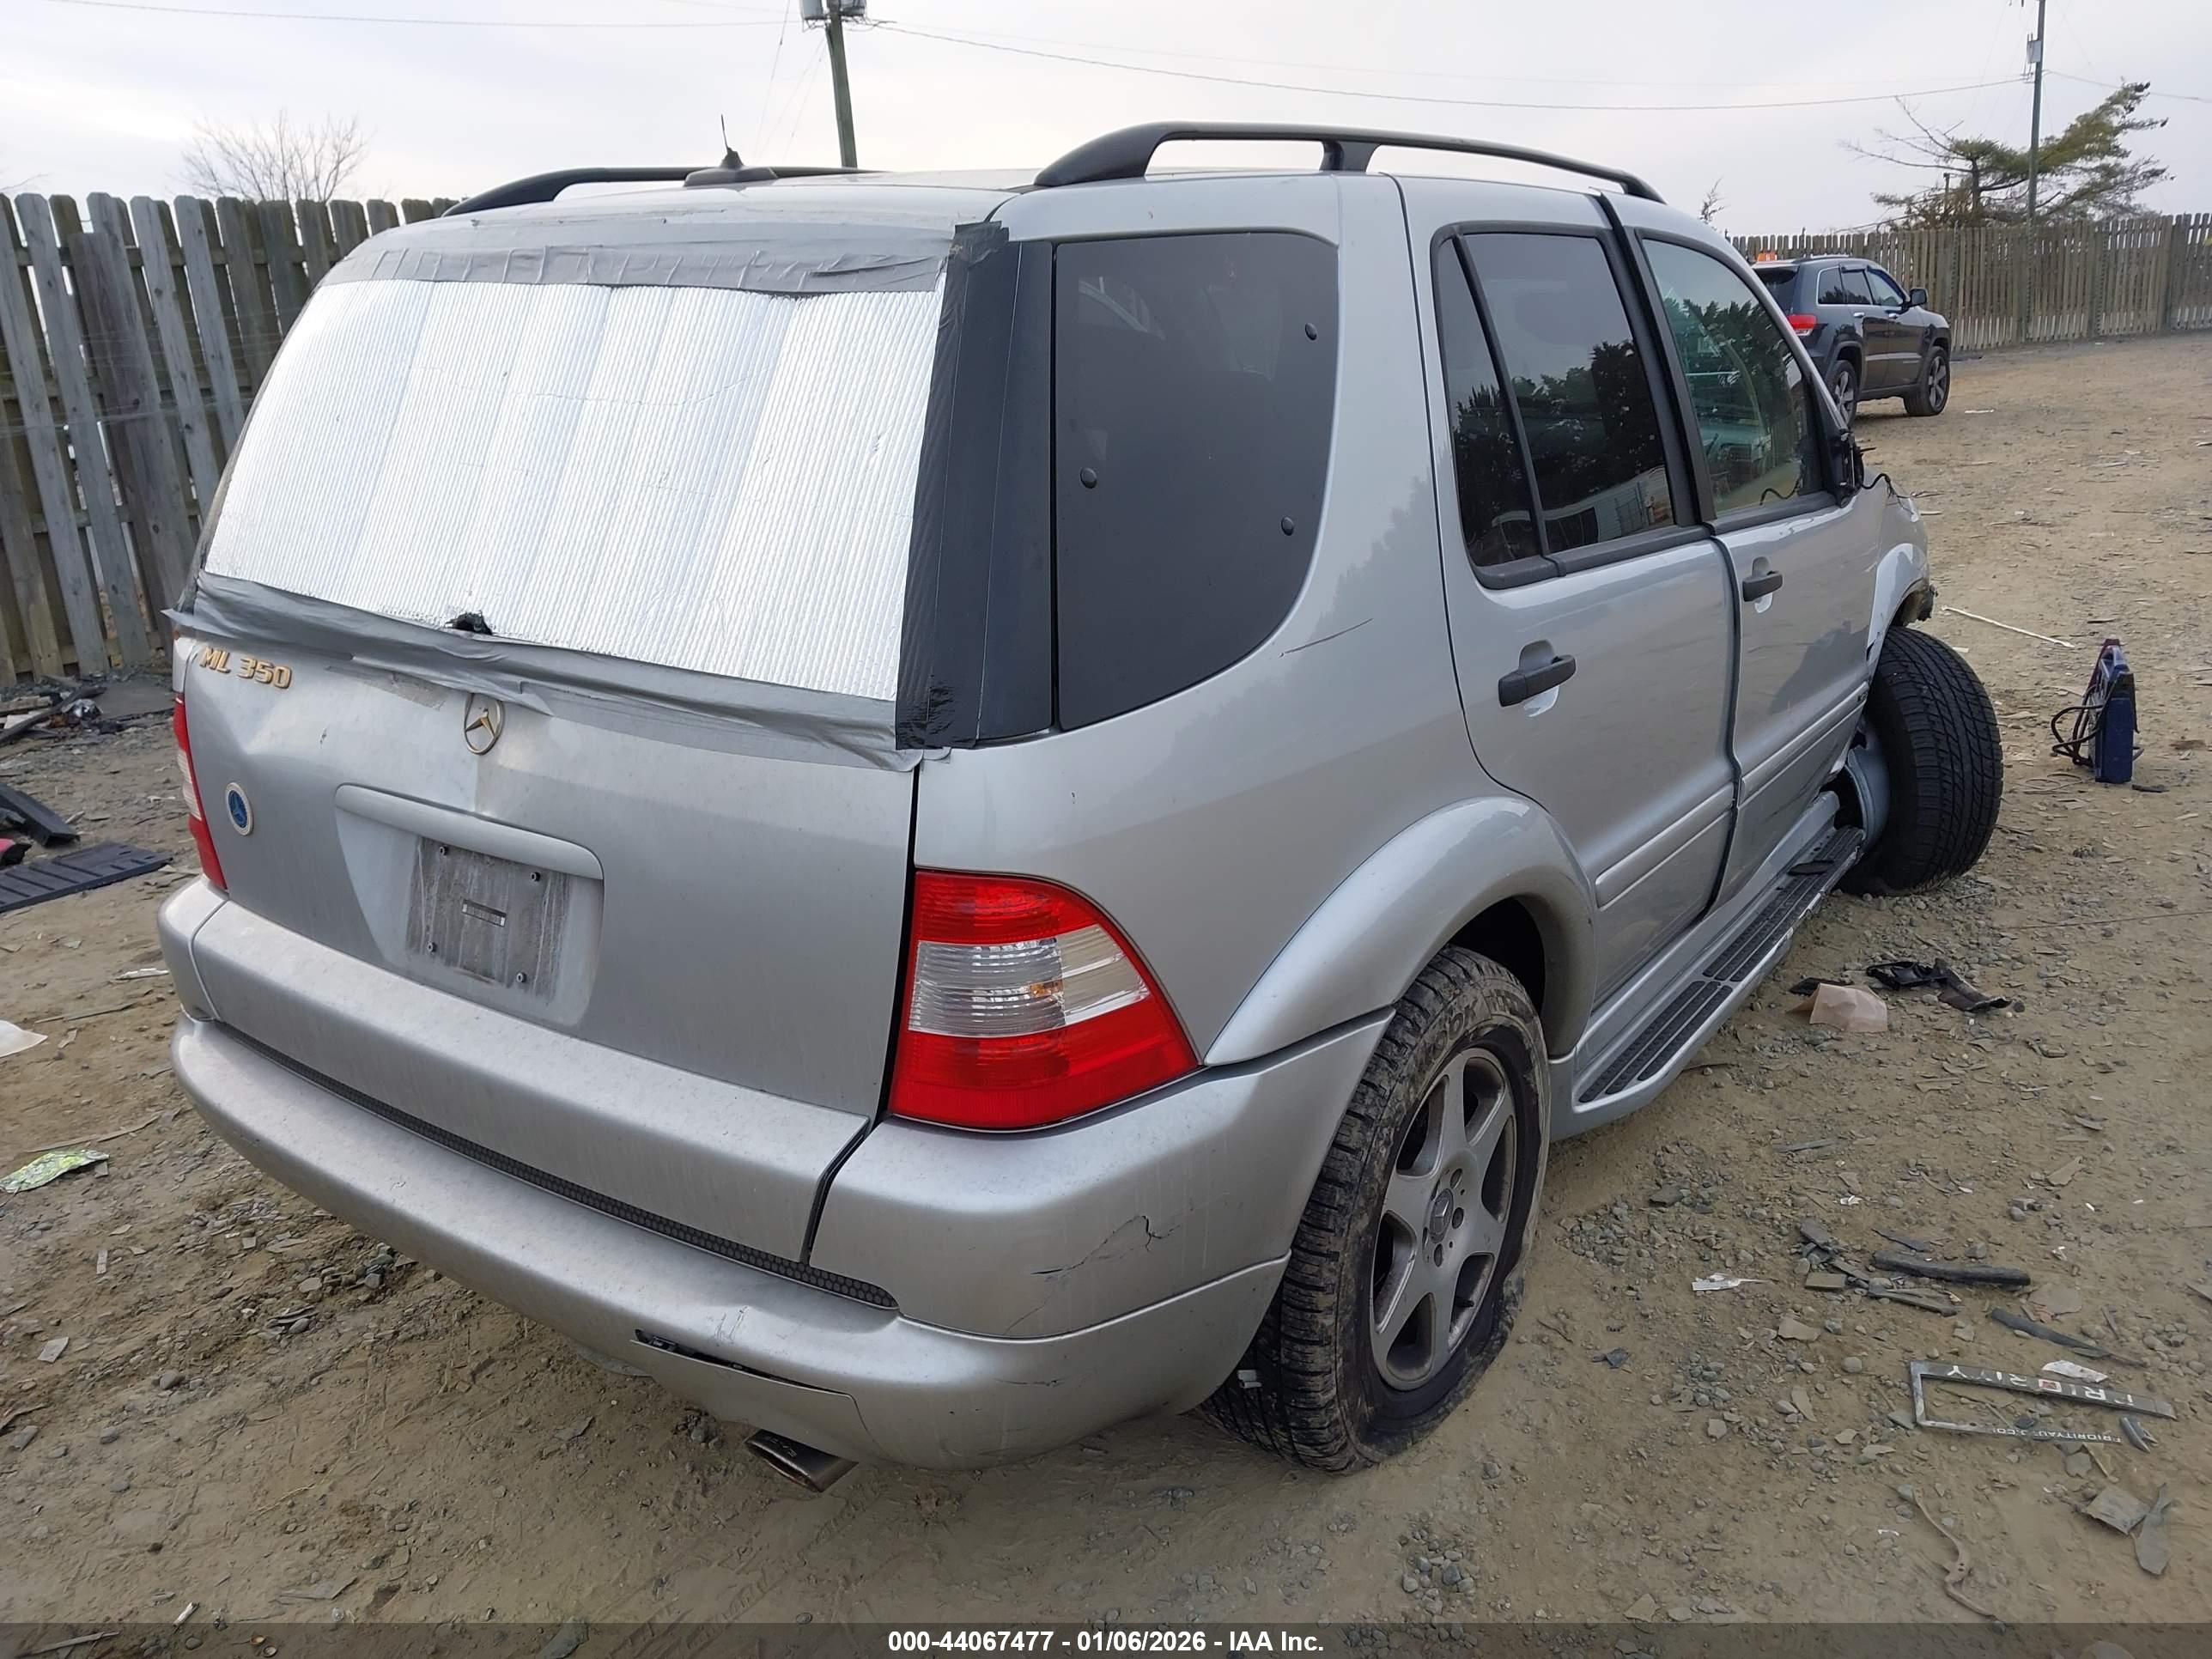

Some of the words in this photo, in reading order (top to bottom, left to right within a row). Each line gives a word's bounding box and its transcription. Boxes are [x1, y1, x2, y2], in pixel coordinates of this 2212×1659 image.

[199, 646, 231, 674] ML
[236, 656, 293, 690] 350
[1992, 1427, 2122, 1443] PRIORITYAUO.CO
